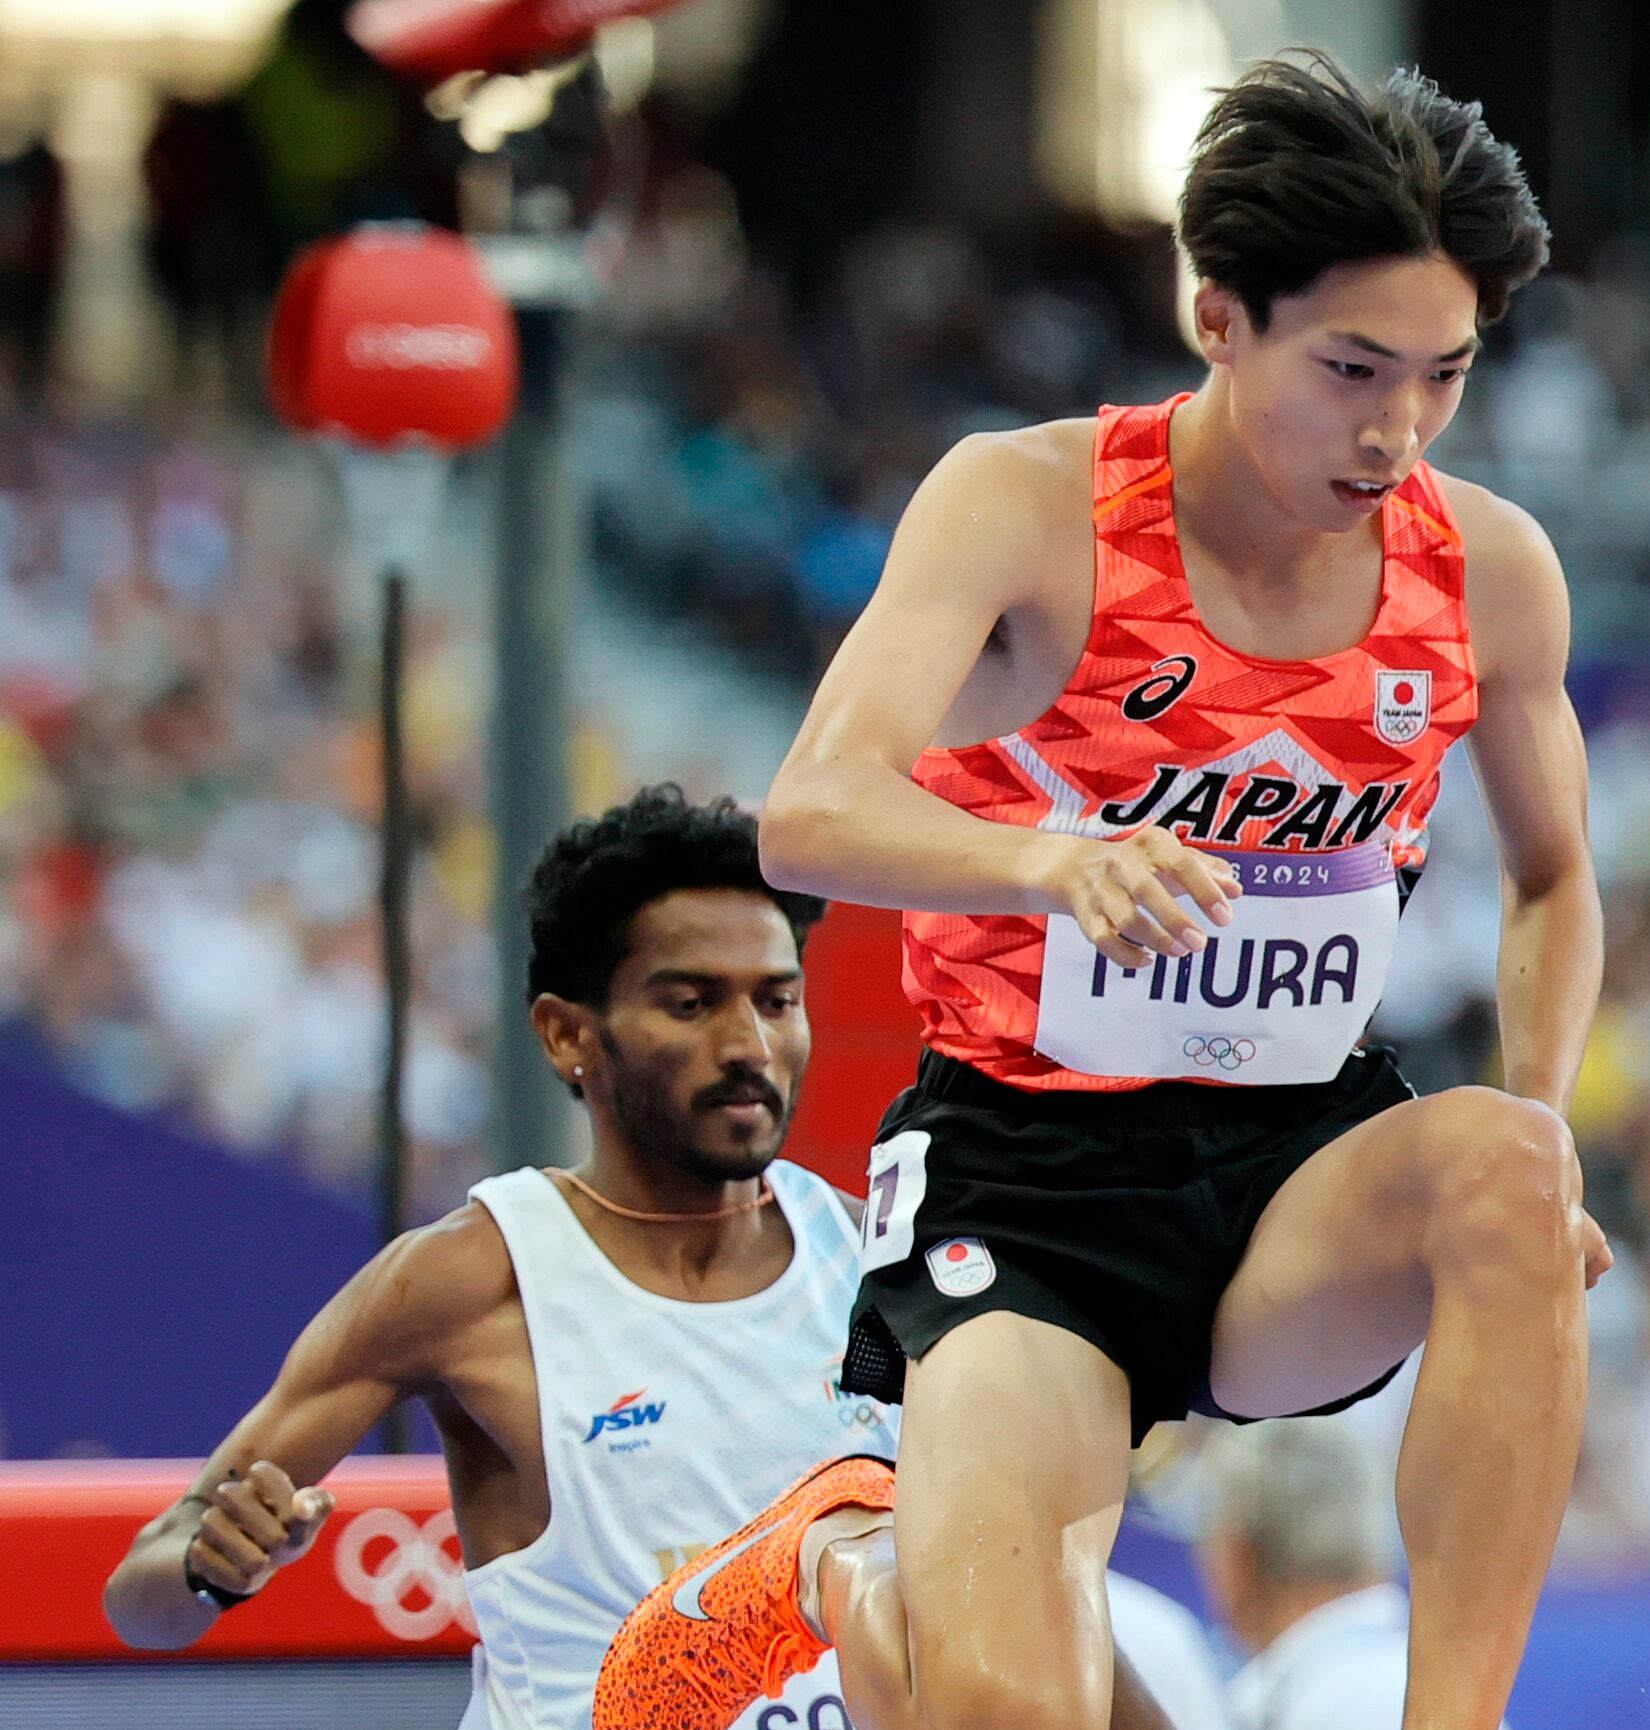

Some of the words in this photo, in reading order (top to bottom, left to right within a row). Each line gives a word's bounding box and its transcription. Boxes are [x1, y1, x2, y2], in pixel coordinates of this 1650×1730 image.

[1101, 765, 1408, 850] JAPAN
[1253, 863, 1330, 886] 2024
[1091, 934, 1359, 1010] MIURA
[582, 1401, 666, 1444] JSW
